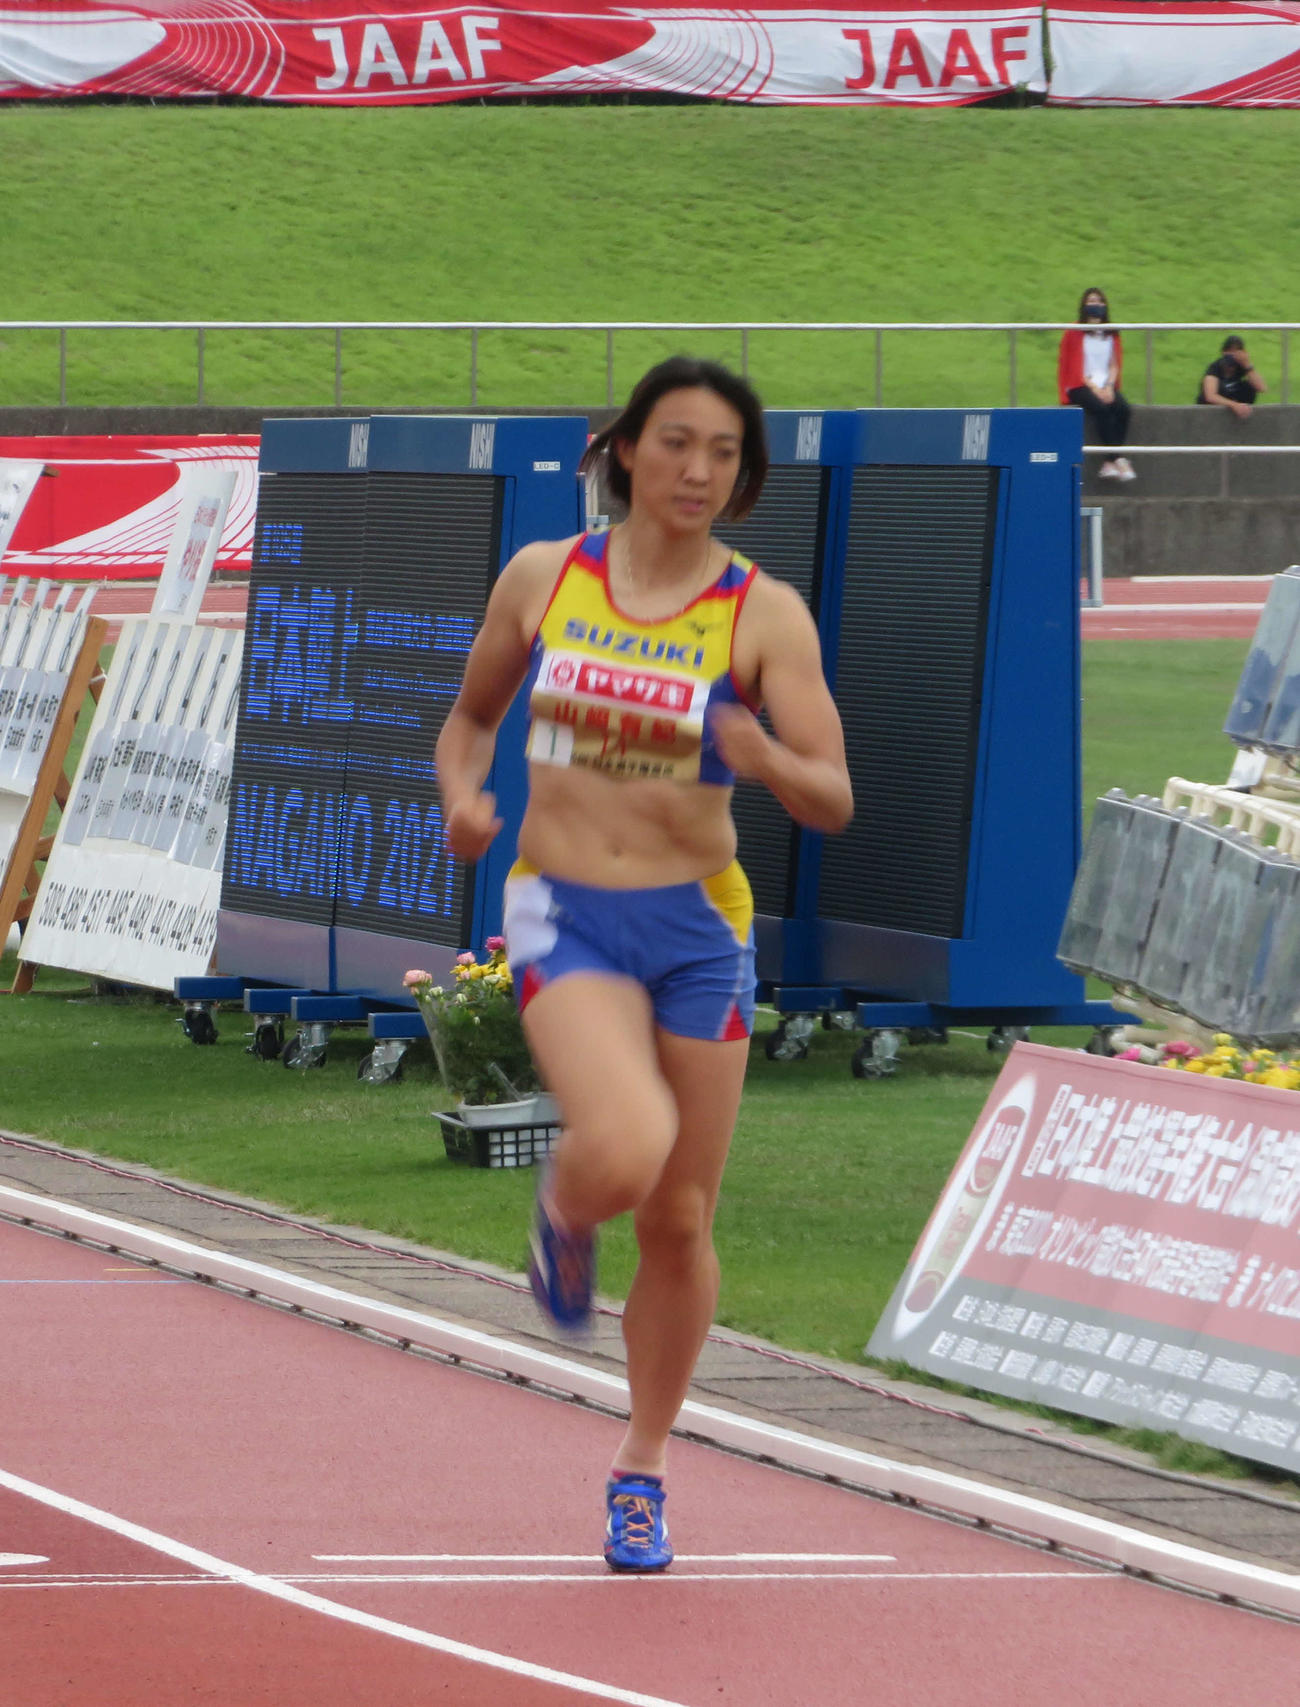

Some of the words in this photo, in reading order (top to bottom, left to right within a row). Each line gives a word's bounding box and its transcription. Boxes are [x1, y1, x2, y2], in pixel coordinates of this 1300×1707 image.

[313, 15, 502, 91] JAAF
[842, 24, 1030, 90] JAAF
[563, 617, 705, 671] SUZUKI
[229, 784, 374, 908] NAGANO
